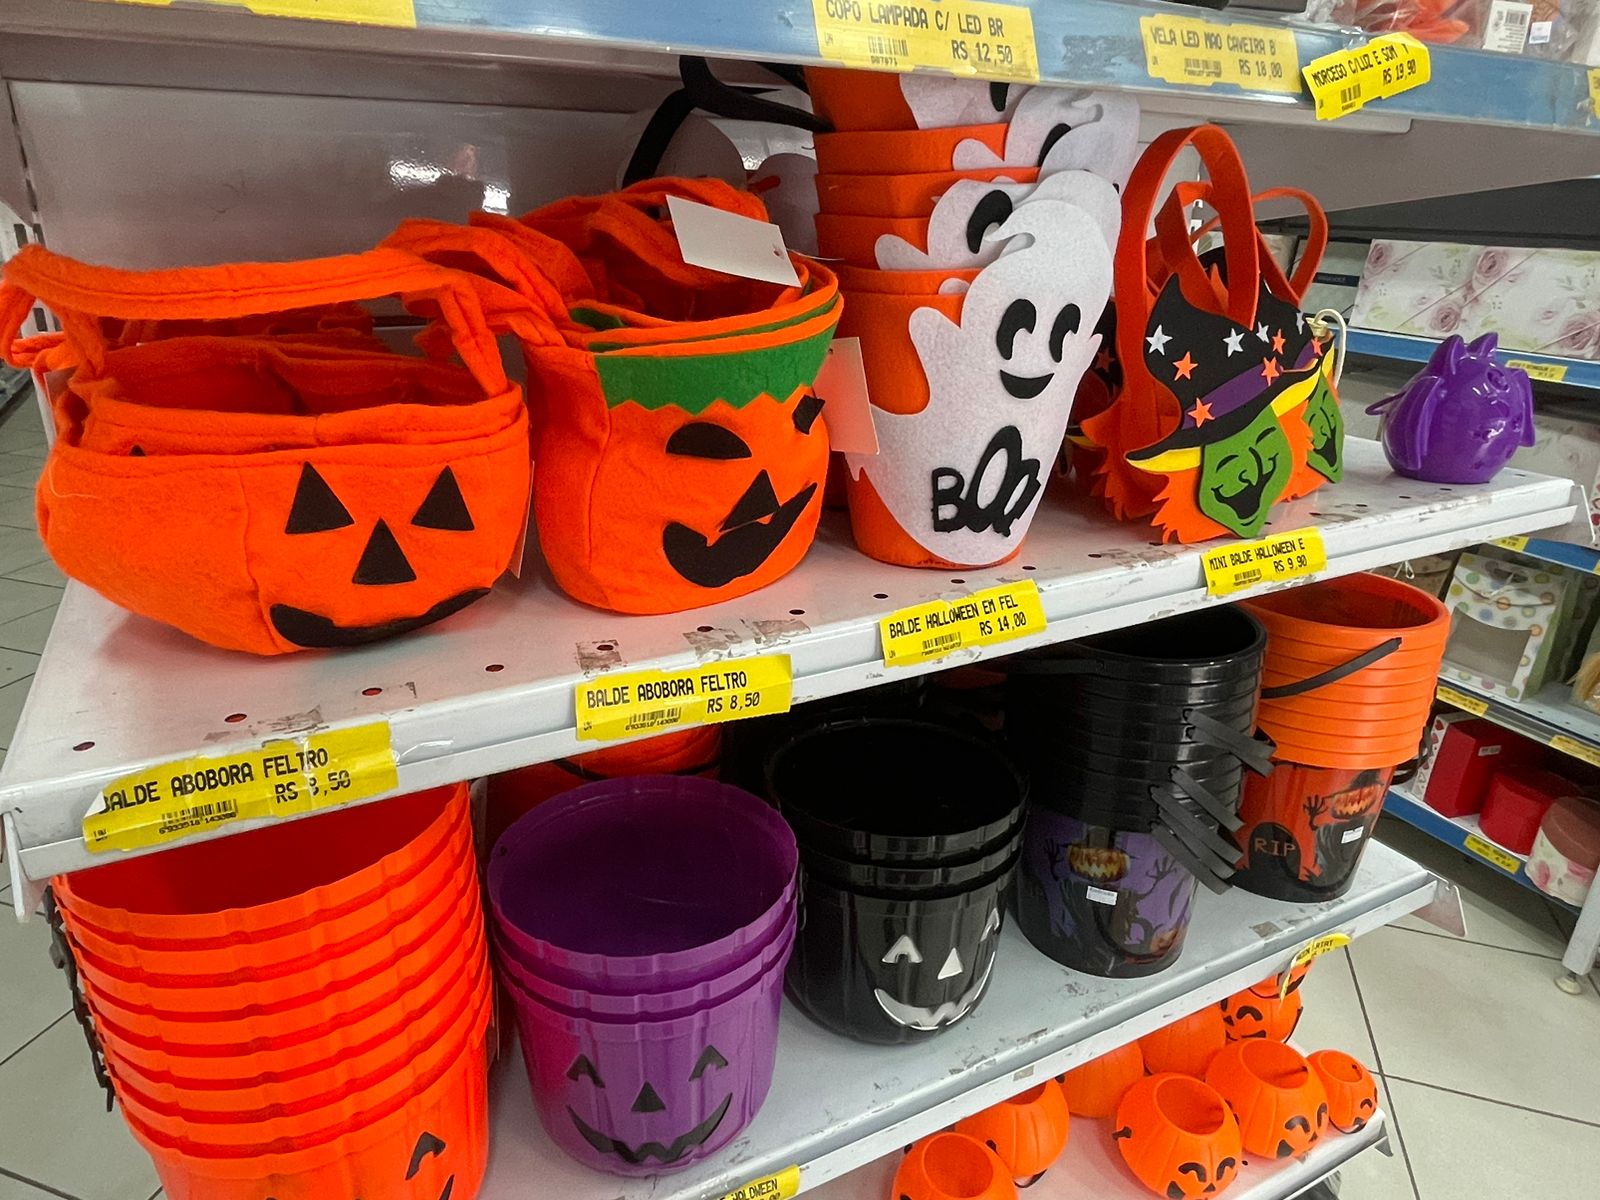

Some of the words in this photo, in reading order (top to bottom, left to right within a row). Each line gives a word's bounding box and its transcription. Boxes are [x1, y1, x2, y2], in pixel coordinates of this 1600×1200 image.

[869, 5, 929, 30] LAMPADA
[958, 14, 982, 35] LED
[989, 18, 1005, 38] BR
[975, 42, 1013, 65] 12,50
[1150, 26, 1177, 46] VELA
[1180, 29, 1200, 48] LED
[1227, 34, 1266, 55] CAVEIRA
[1312, 63, 1348, 88] MORCEGO
[1209, 557, 1228, 571] MINI
[1230, 550, 1253, 566] BALDE
[1254, 540, 1296, 560] HALLOWEEN
[889, 617, 922, 639] BALDE
[925, 602, 980, 630] HALLOWEEN
[982, 599, 997, 615] EM
[999, 594, 1018, 610] FEL
[998, 612, 1027, 632] 14,00
[587, 686, 630, 708] BALDE
[637, 677, 695, 702] ABOBORA
[700, 670, 747, 693] FELTRO
[730, 691, 760, 711] 8,50
[171, 762, 254, 797] ABOBORA
[263, 747, 329, 778] FELTRO
[1254, 838, 1296, 857] RIP
